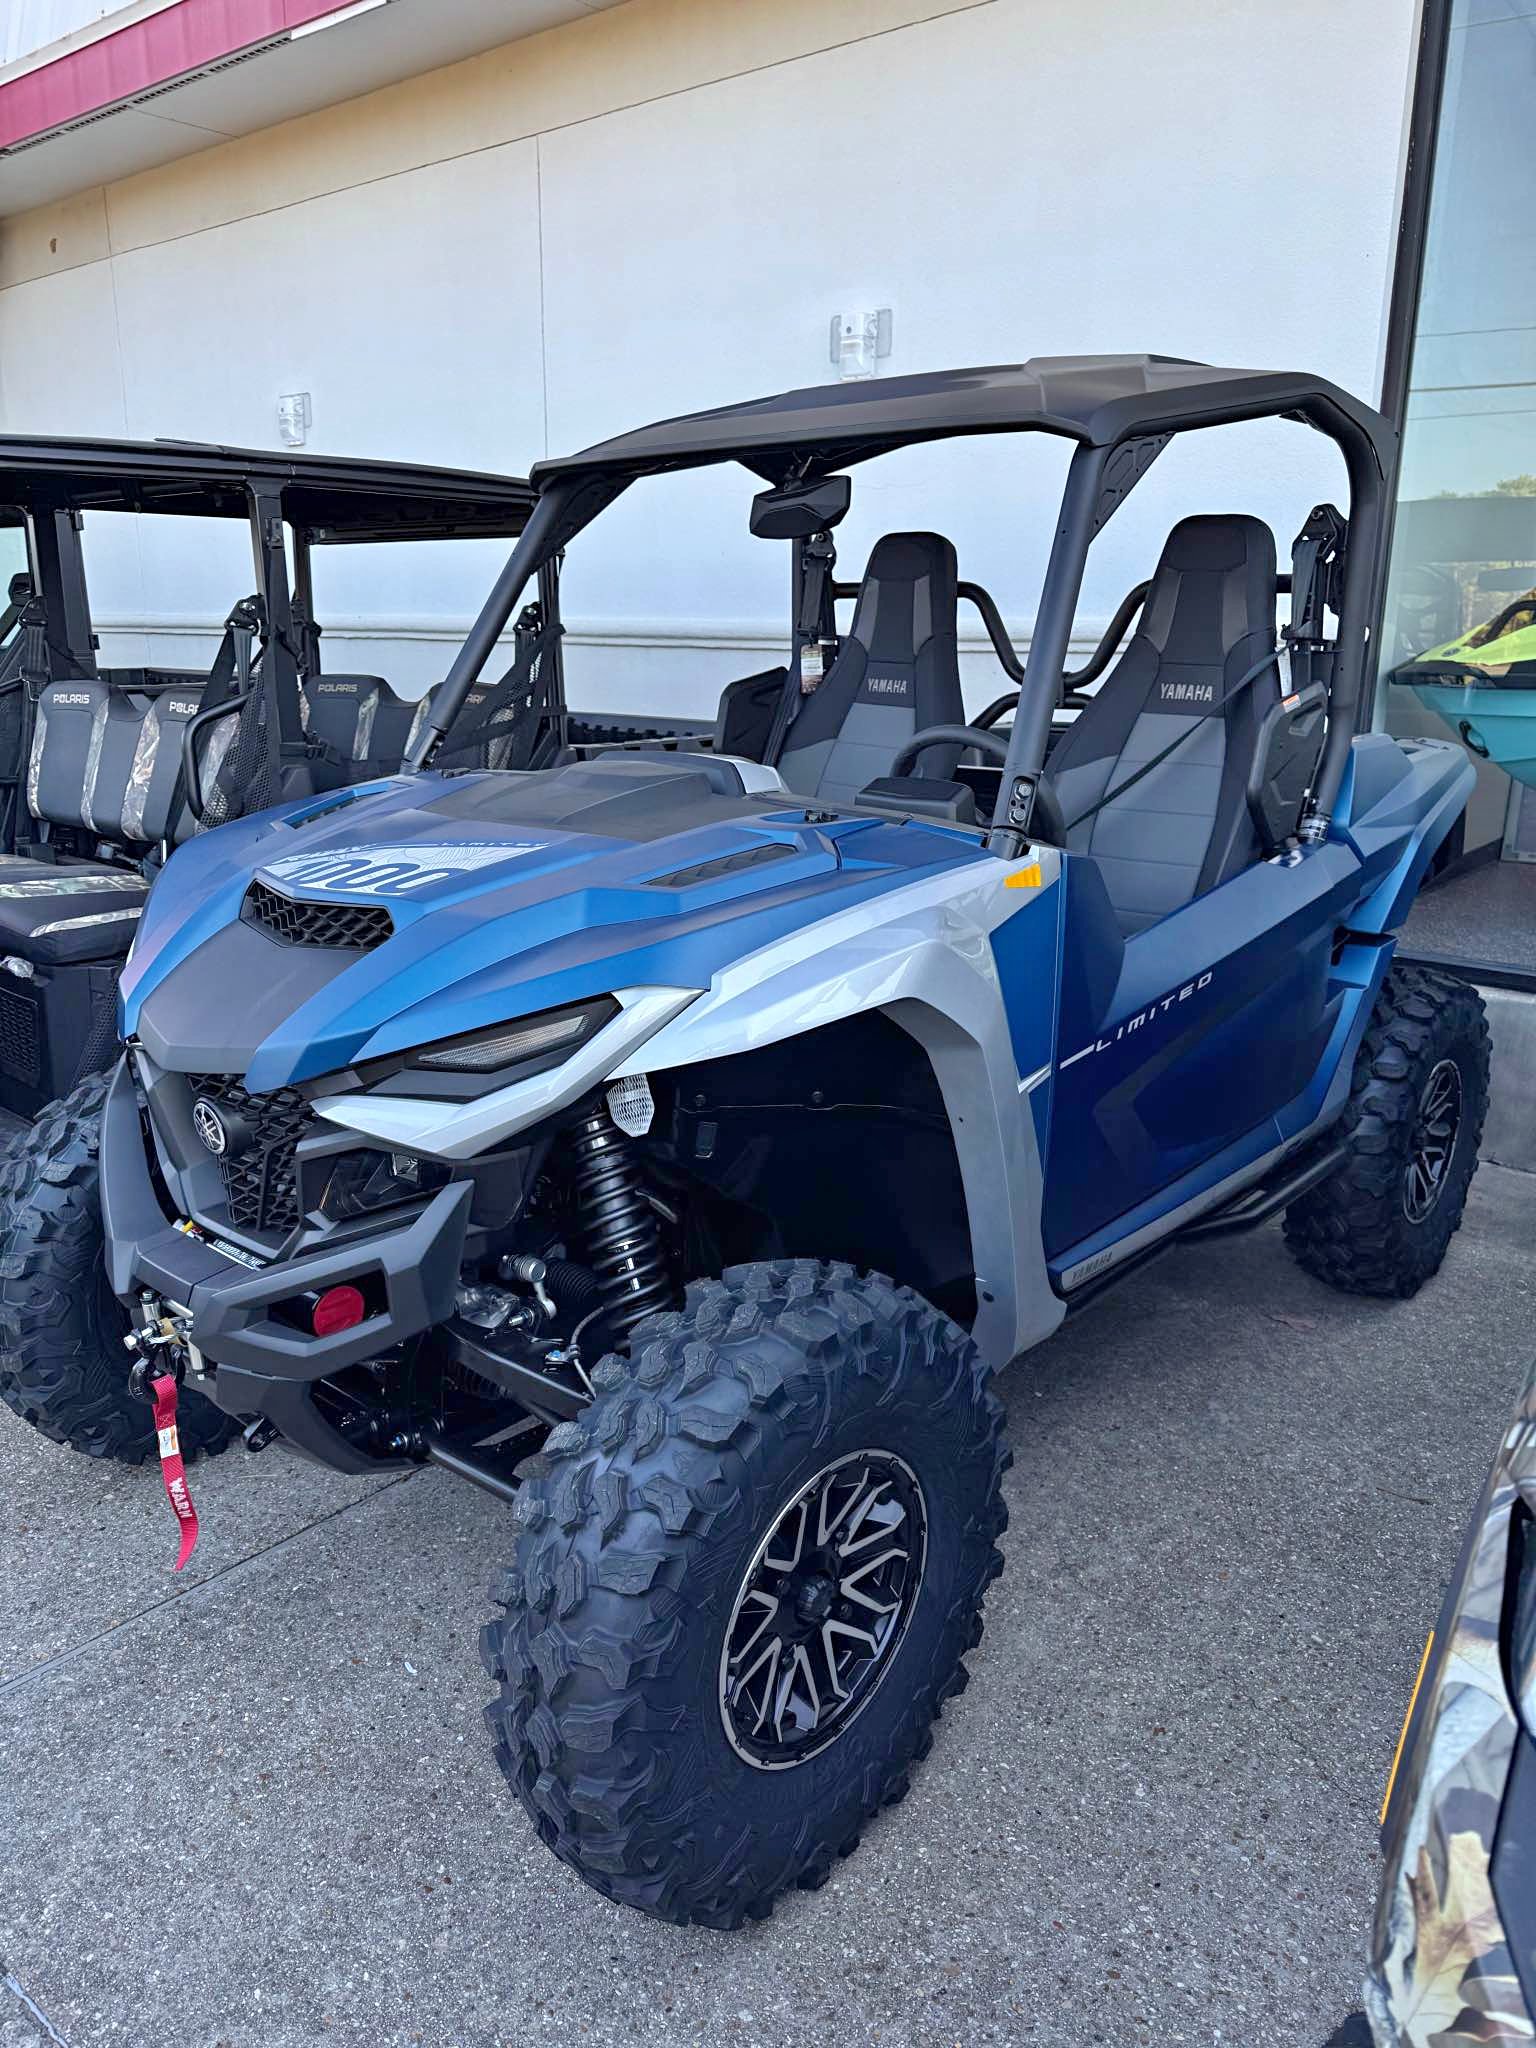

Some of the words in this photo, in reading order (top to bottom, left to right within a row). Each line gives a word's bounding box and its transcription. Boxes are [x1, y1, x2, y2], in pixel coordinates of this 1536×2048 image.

[317, 683, 358, 693] POLARIS
[868, 678, 907, 694] YAMAHA
[1161, 682, 1213, 701] YAMAHA
[53, 693, 90, 704] POLARIS
[1096, 971, 1213, 1052] LIMITED
[168, 1476, 193, 1519] WARN
